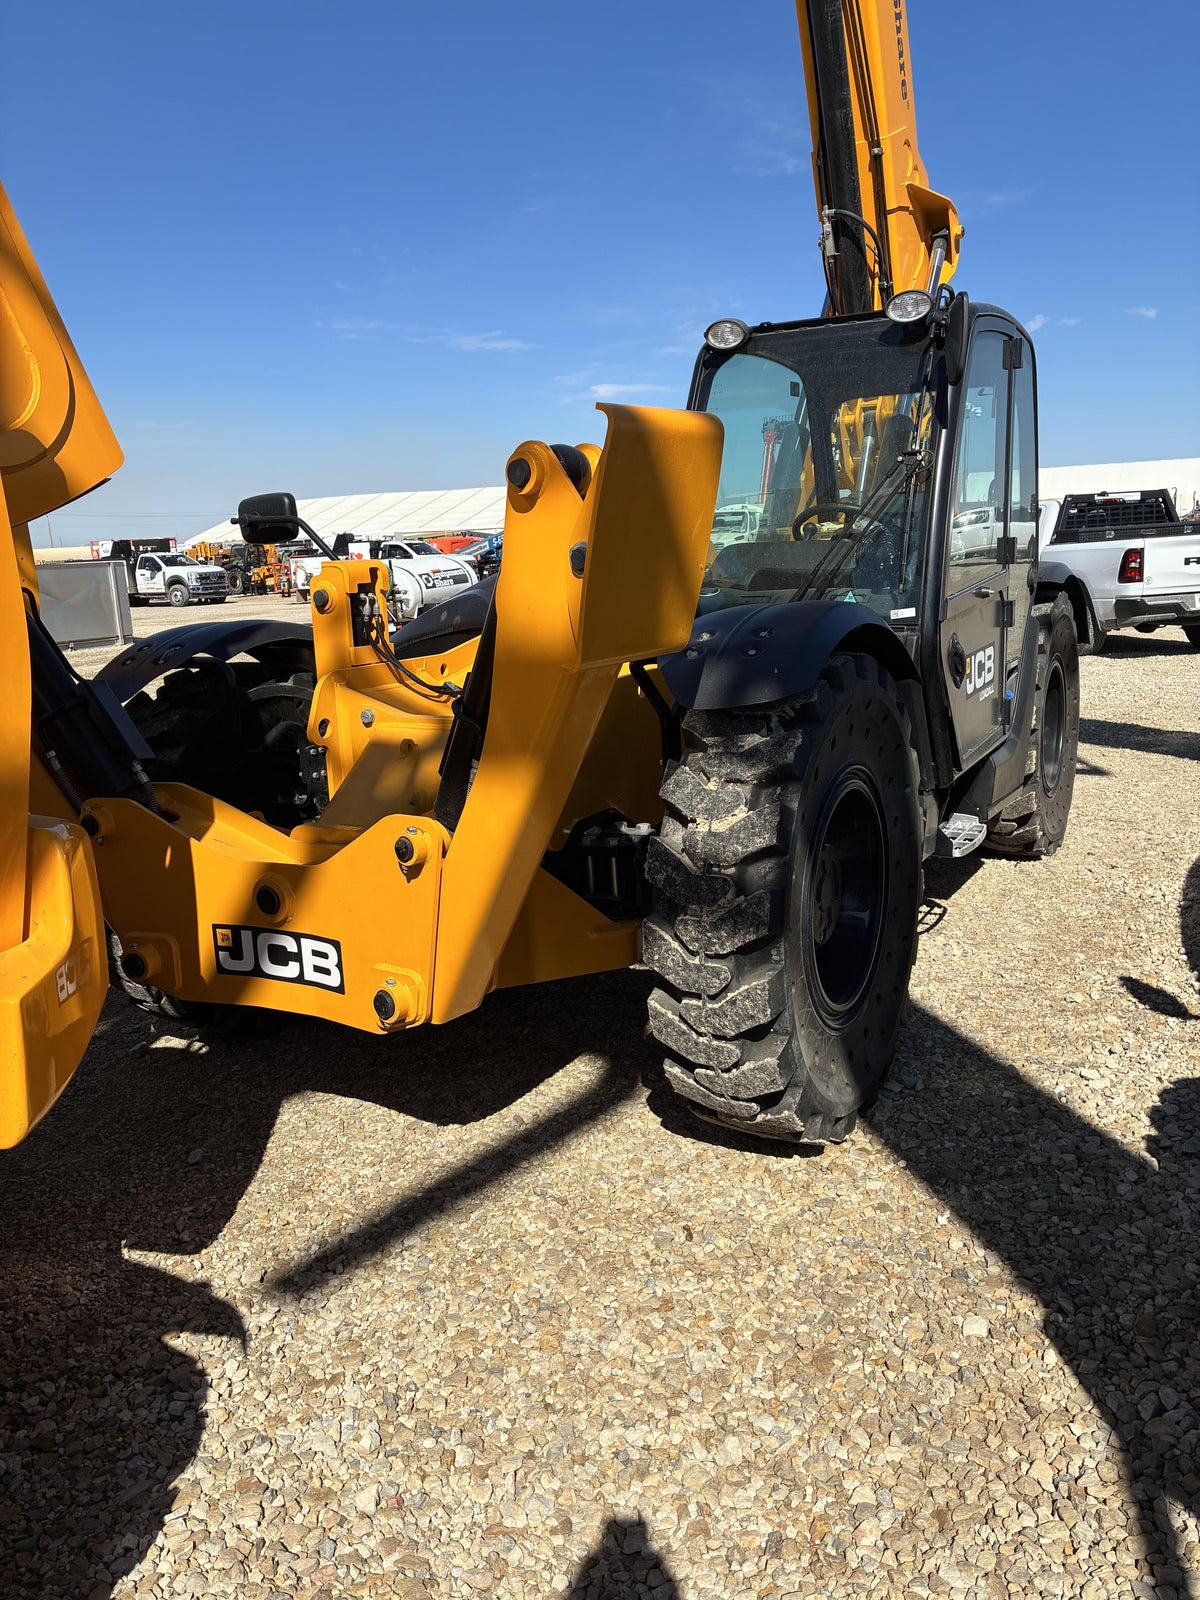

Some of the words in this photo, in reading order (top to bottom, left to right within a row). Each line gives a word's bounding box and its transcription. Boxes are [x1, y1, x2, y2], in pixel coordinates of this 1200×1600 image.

[435, 579, 455, 587] Share
[966, 645, 995, 695] JCB
[218, 929, 342, 988] JCB
